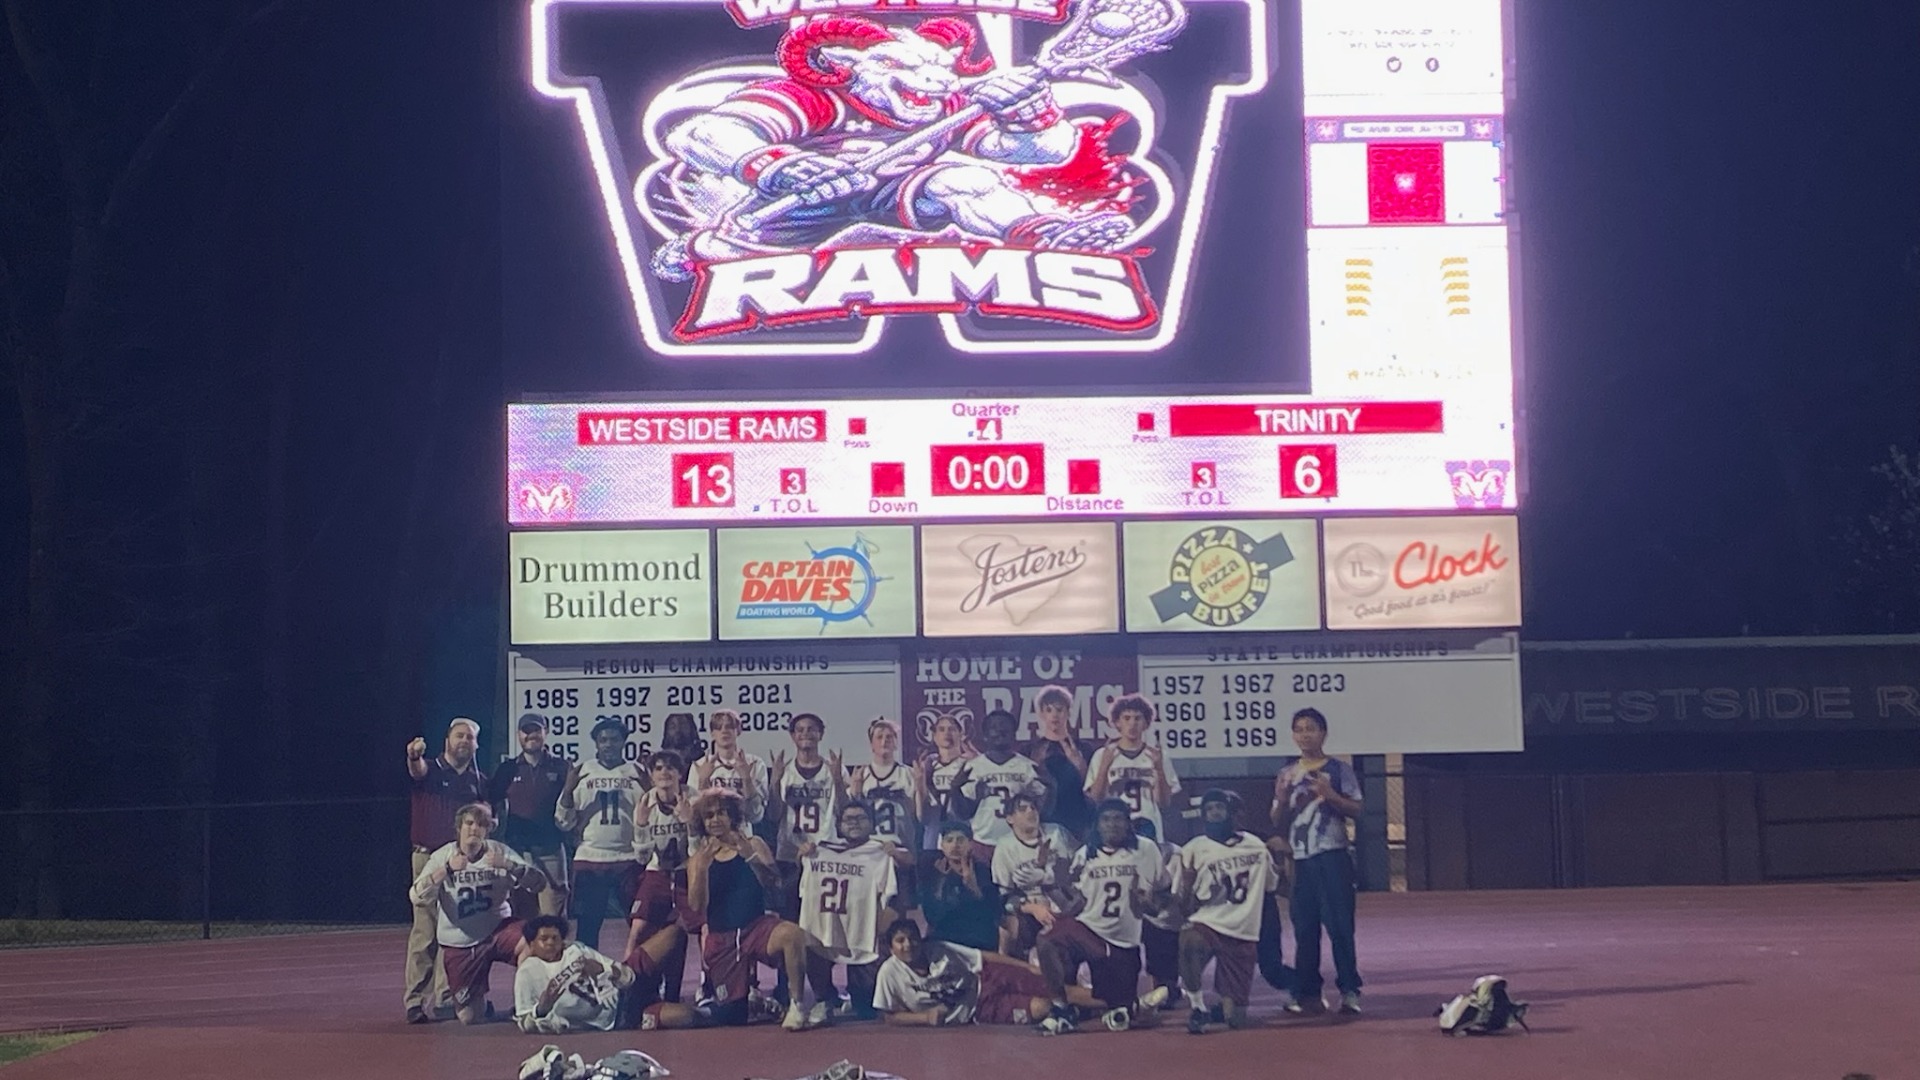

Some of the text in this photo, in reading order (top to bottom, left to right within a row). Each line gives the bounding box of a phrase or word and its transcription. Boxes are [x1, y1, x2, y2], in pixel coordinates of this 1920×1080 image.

[695, 248, 1141, 328] RAMS
[952, 403, 1019, 418] Quarter
[1255, 408, 1361, 433] TRINITY
[588, 416, 817, 442] WESTSIDE RAMS
[979, 419, 1001, 440] 4
[681, 465, 733, 504] 13
[787, 472, 801, 492] 3
[949, 455, 1029, 490] 0:00
[1197, 468, 1212, 488] 3
[1294, 456, 1323, 493] 6
[868, 499, 918, 513] Down
[1046, 496, 1124, 511] Distance
[1172, 528, 1238, 582] PIZZA
[1393, 533, 1508, 589] Clock
[519, 553, 702, 583] Drummond
[742, 560, 855, 578] CAPTAIN
[960, 542, 1087, 613] Jostens
[741, 577, 853, 602] DAVES
[1191, 561, 1269, 625] BUFFET
[544, 591, 678, 620] Builders
[740, 606, 815, 616] BOATING WORLD
[1207, 641, 1449, 663] STATE CHAMPIONSHIPS
[583, 655, 830, 675] REGION CHAMPIONSHIPS
[916, 650, 1081, 682] HOME OF
[524, 684, 793, 709] 1985 1997 2015 2021
[924, 688, 966, 706] THE
[1152, 673, 1347, 696] 1957 1967 2023
[1154, 701, 1276, 722] 1960 1968
[1524, 687, 1855, 723] WESTSIDE
[544, 715, 580, 735] 92
[1154, 728, 1277, 749] 1962 1969
[586, 777, 634, 790] WESTSIDE
[597, 790, 621, 825] 11
[793, 801, 820, 834] 19
[810, 861, 866, 877] WESTSIDE
[457, 884, 493, 920] 25
[820, 877, 849, 915] 21
[1102, 882, 1122, 918] 2
